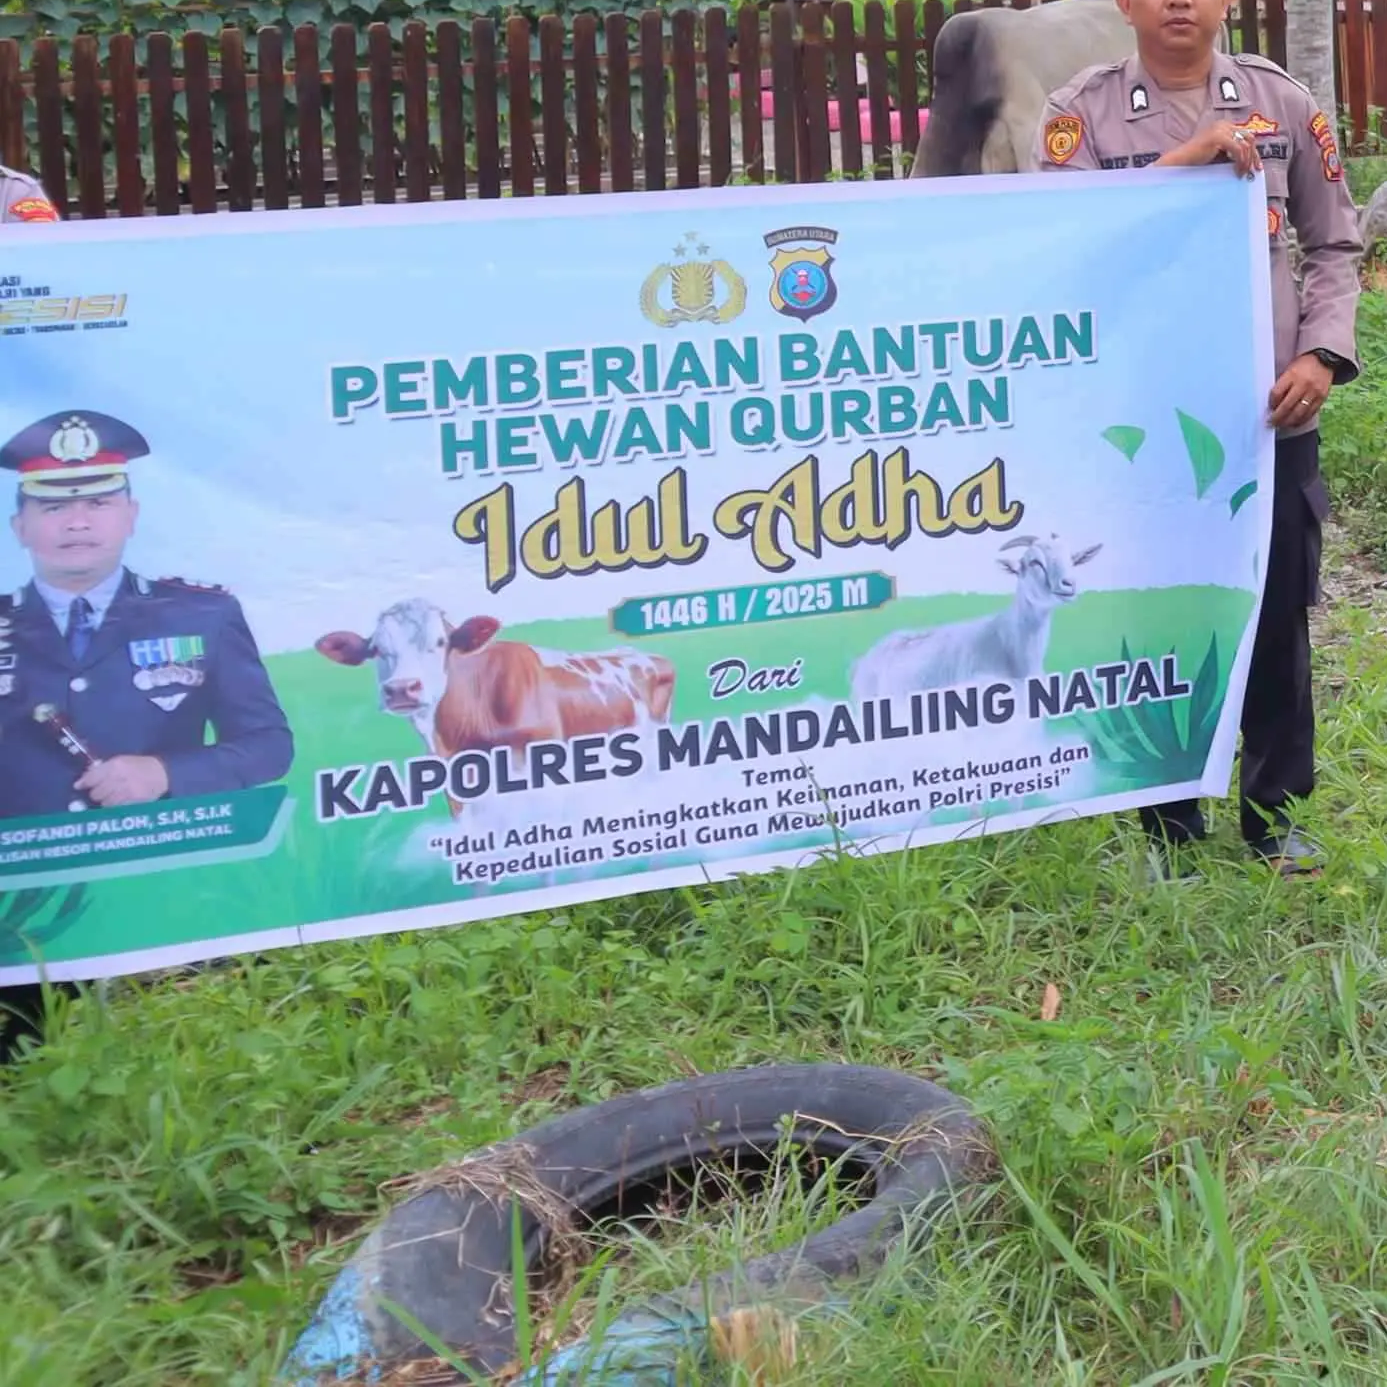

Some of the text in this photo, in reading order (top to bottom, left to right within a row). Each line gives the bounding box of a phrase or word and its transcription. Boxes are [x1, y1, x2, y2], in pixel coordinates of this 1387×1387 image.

[330, 310, 1094, 418] PEMBERIAN BANTUAN
[439, 375, 1010, 473] HEWAN QURBAN
[452, 445, 1025, 594] Idul Adha
[640, 576, 869, 630] 1446 H / 2025 M
[707, 658, 802, 698] Dari
[319, 654, 1189, 819] KAPOLRES MANDAILIING NATAL
[743, 764, 814, 787] Tema:
[0, 824, 83, 846] SOFANDI
[86, 816, 153, 836] PALOH,
[193, 803, 233, 821] S.I.K
[44, 843, 91, 859] RESOR
[185, 822, 233, 840] NATAL
[455, 846, 604, 883] Kepedulian
[611, 833, 687, 857] Sosial
[694, 824, 759, 846] Guna
[766, 797, 921, 836] Mewujudkan
[929, 784, 982, 809] Polri
[504, 824, 573, 848] Adha
[582, 795, 768, 836] Meningkatkan
[777, 776, 905, 806] Keimanan,
[912, 755, 1042, 787] Ketakwaan
[1049, 744, 1090, 766] dan
